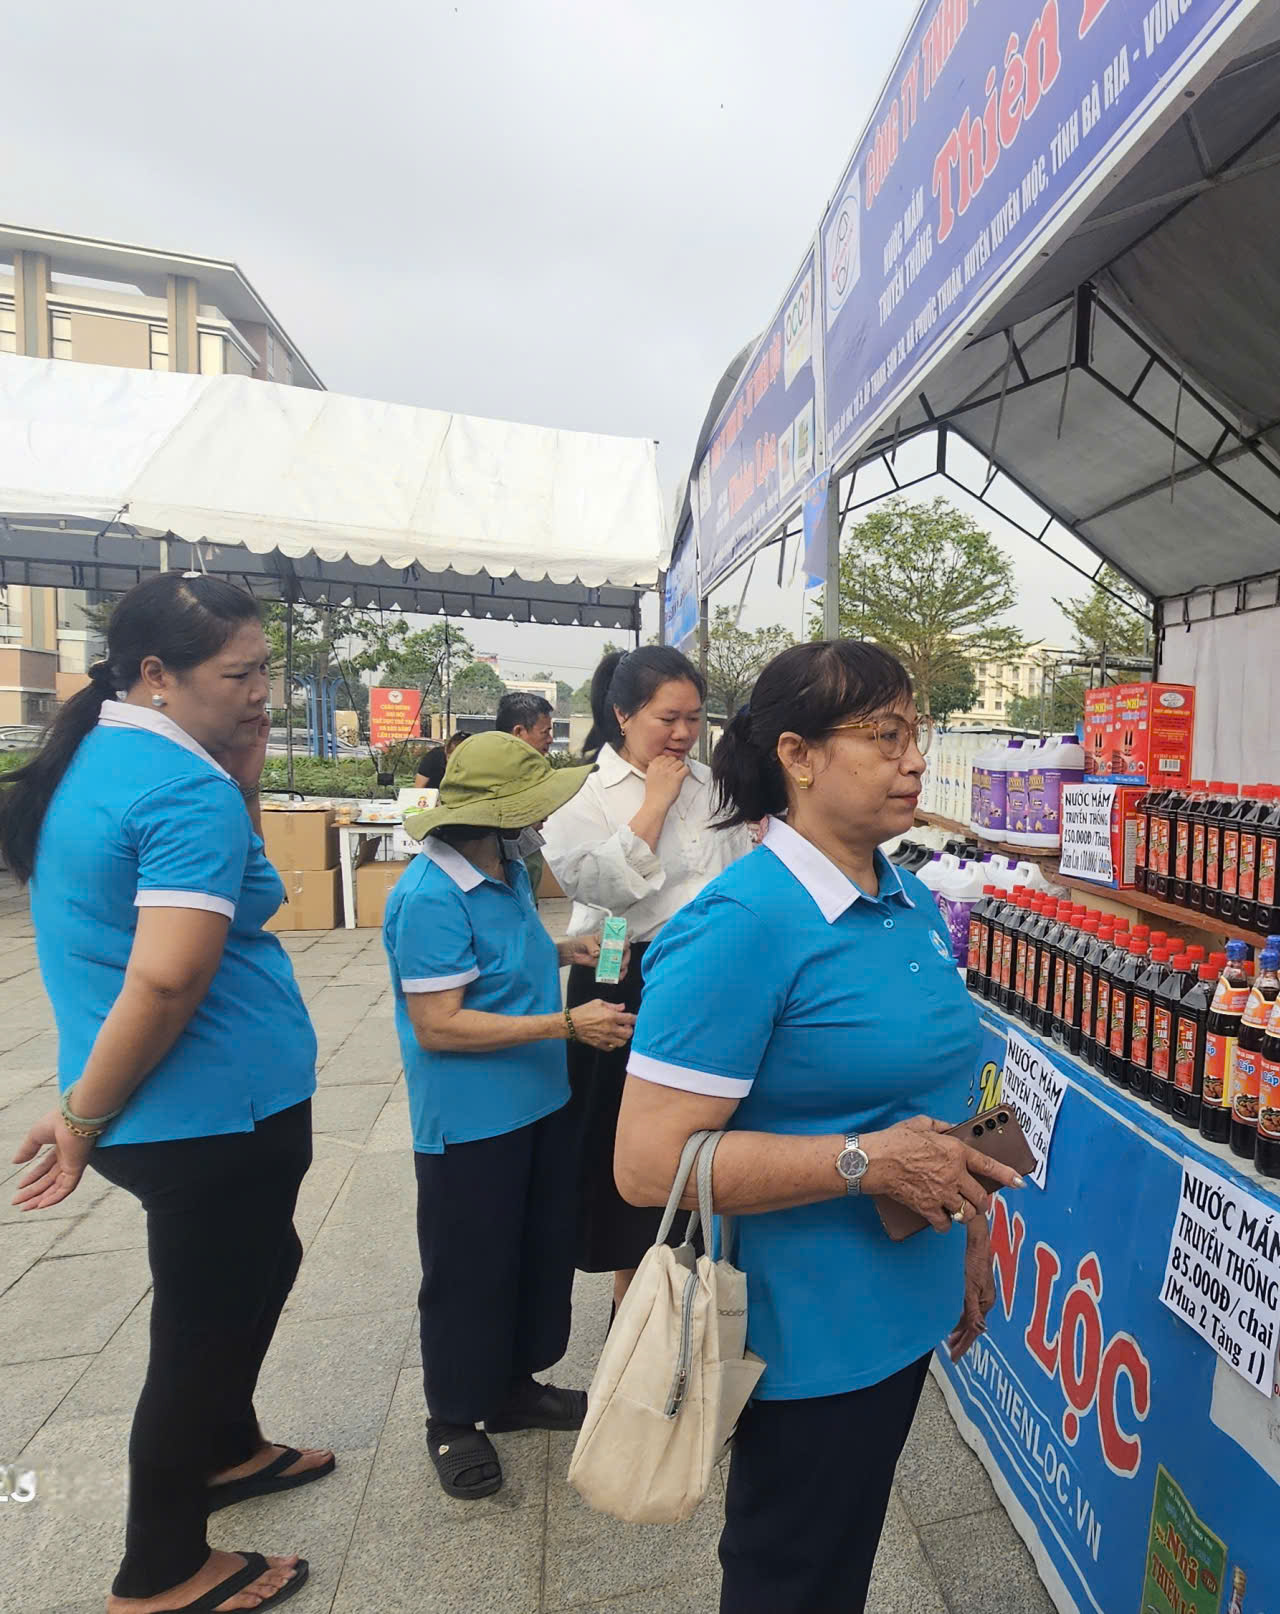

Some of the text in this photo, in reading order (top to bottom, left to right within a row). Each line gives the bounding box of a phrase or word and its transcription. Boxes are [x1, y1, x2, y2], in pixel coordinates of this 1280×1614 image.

[902, 55, 920, 144] TY
[1103, 43, 1130, 112] RỊA
[1065, 786, 1112, 808] NƯỚC MẮM
[1007, 1037, 1063, 1108] NƯỚC MẮM
[1182, 1170, 1238, 1232] NƯỚC
[1226, 1247, 1280, 1312] THỐNG
[1025, 1240, 1151, 1479] LỘC
[1164, 1274, 1266, 1385] (Mua 2 Tặng 1)
